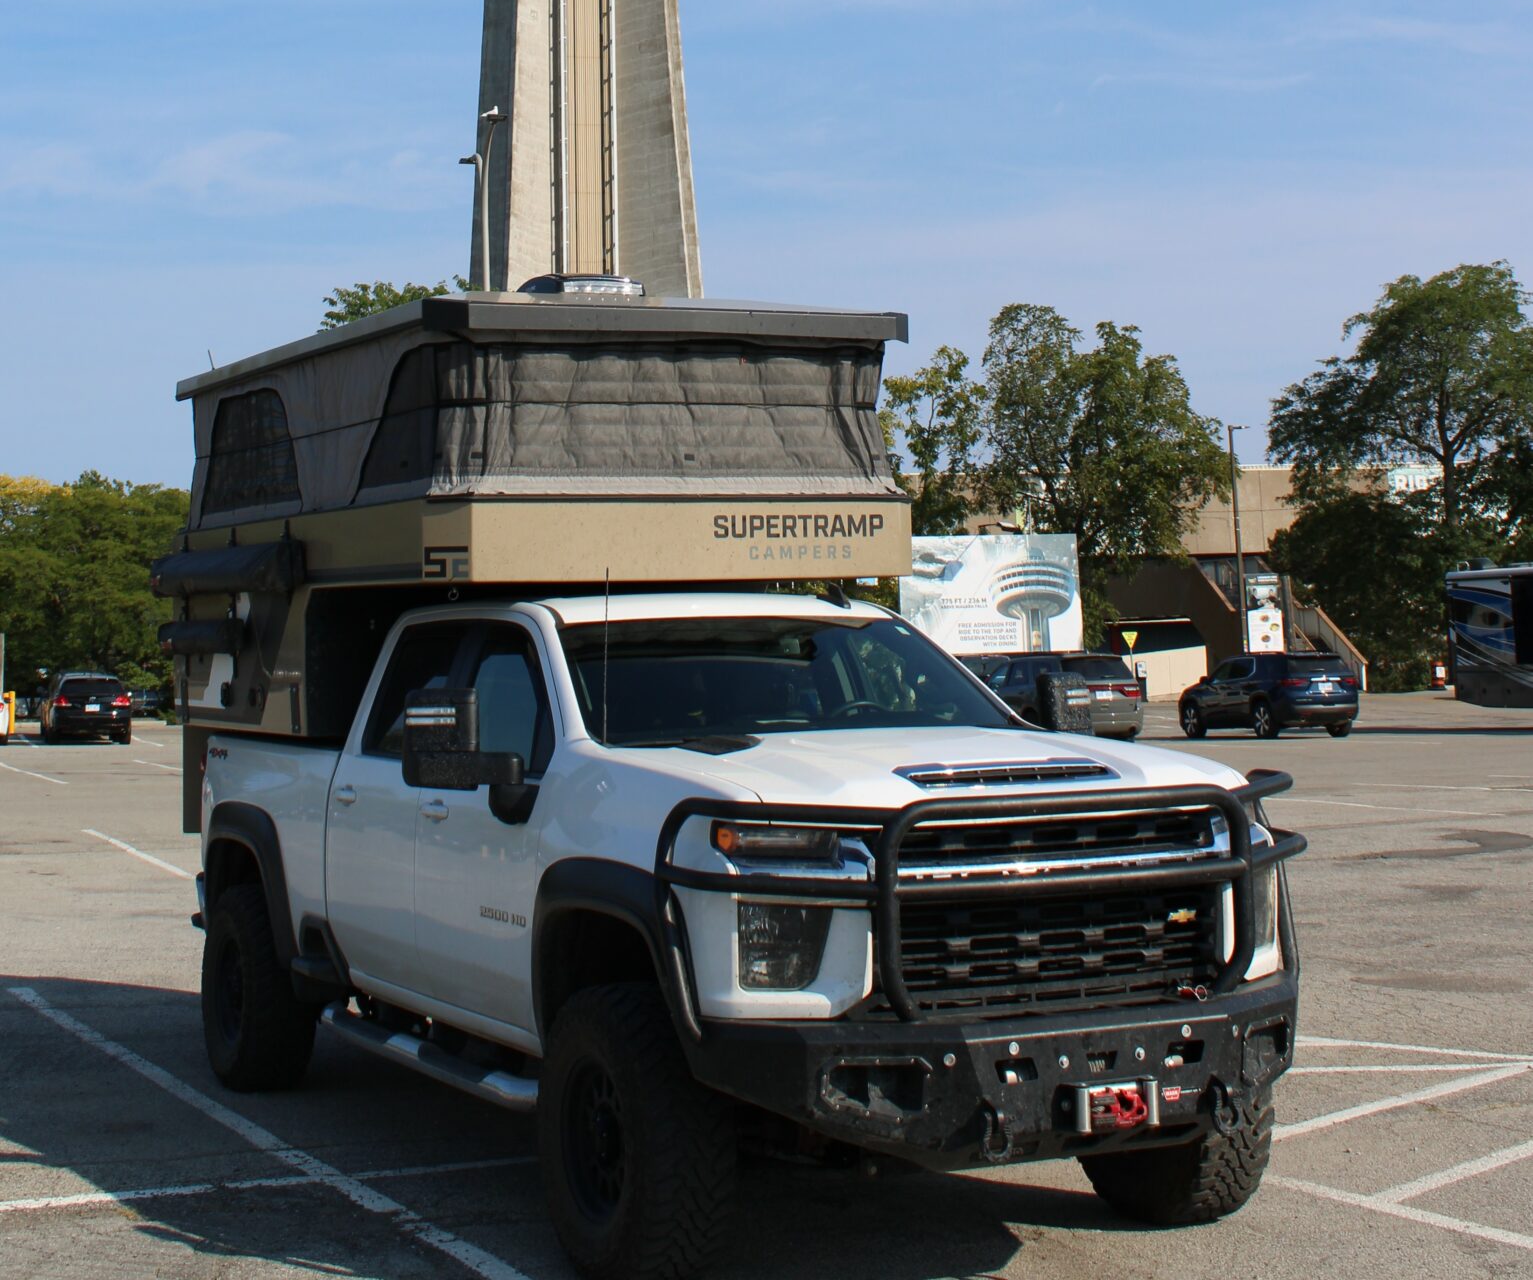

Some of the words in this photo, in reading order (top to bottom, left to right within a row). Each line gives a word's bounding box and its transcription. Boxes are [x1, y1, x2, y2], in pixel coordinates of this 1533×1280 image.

[713, 513, 884, 538] SUPERTRAMP
[748, 544, 852, 560] CAMPERS
[480, 906, 509, 923] 2500
[512, 912, 526, 928] HD
